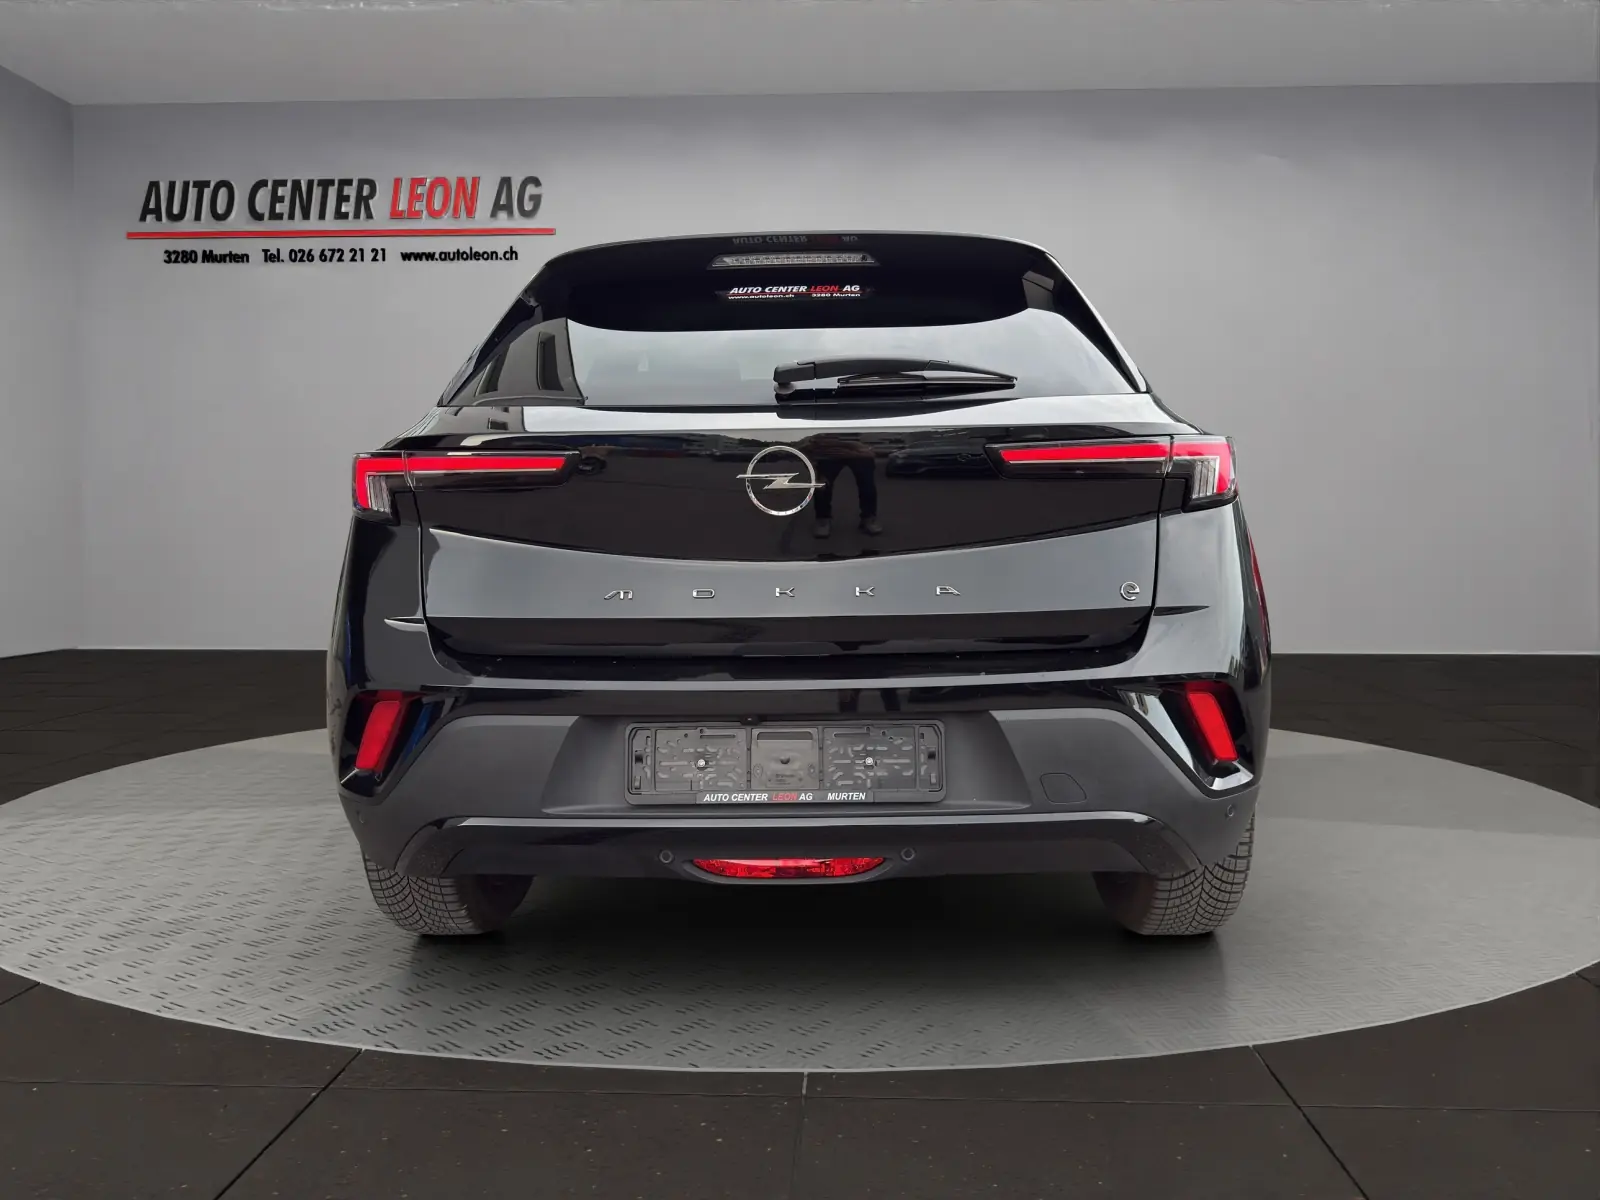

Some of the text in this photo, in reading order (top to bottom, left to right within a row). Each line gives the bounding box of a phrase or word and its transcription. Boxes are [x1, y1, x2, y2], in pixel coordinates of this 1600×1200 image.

[139, 175, 543, 222] AUTO CENTER LEON AG
[163, 246, 518, 264] 3280 Murten Tel. 026 672 21 21 www.autoleon.ch
[729, 286, 762, 294] AUTO
[764, 285, 808, 293] CENTER
[843, 284, 860, 292] AG
[604, 585, 961, 600] MOKKA
[1120, 581, 1140, 601] e
[703, 792, 867, 802] AUTO CENTER LEON AG MURTEN
